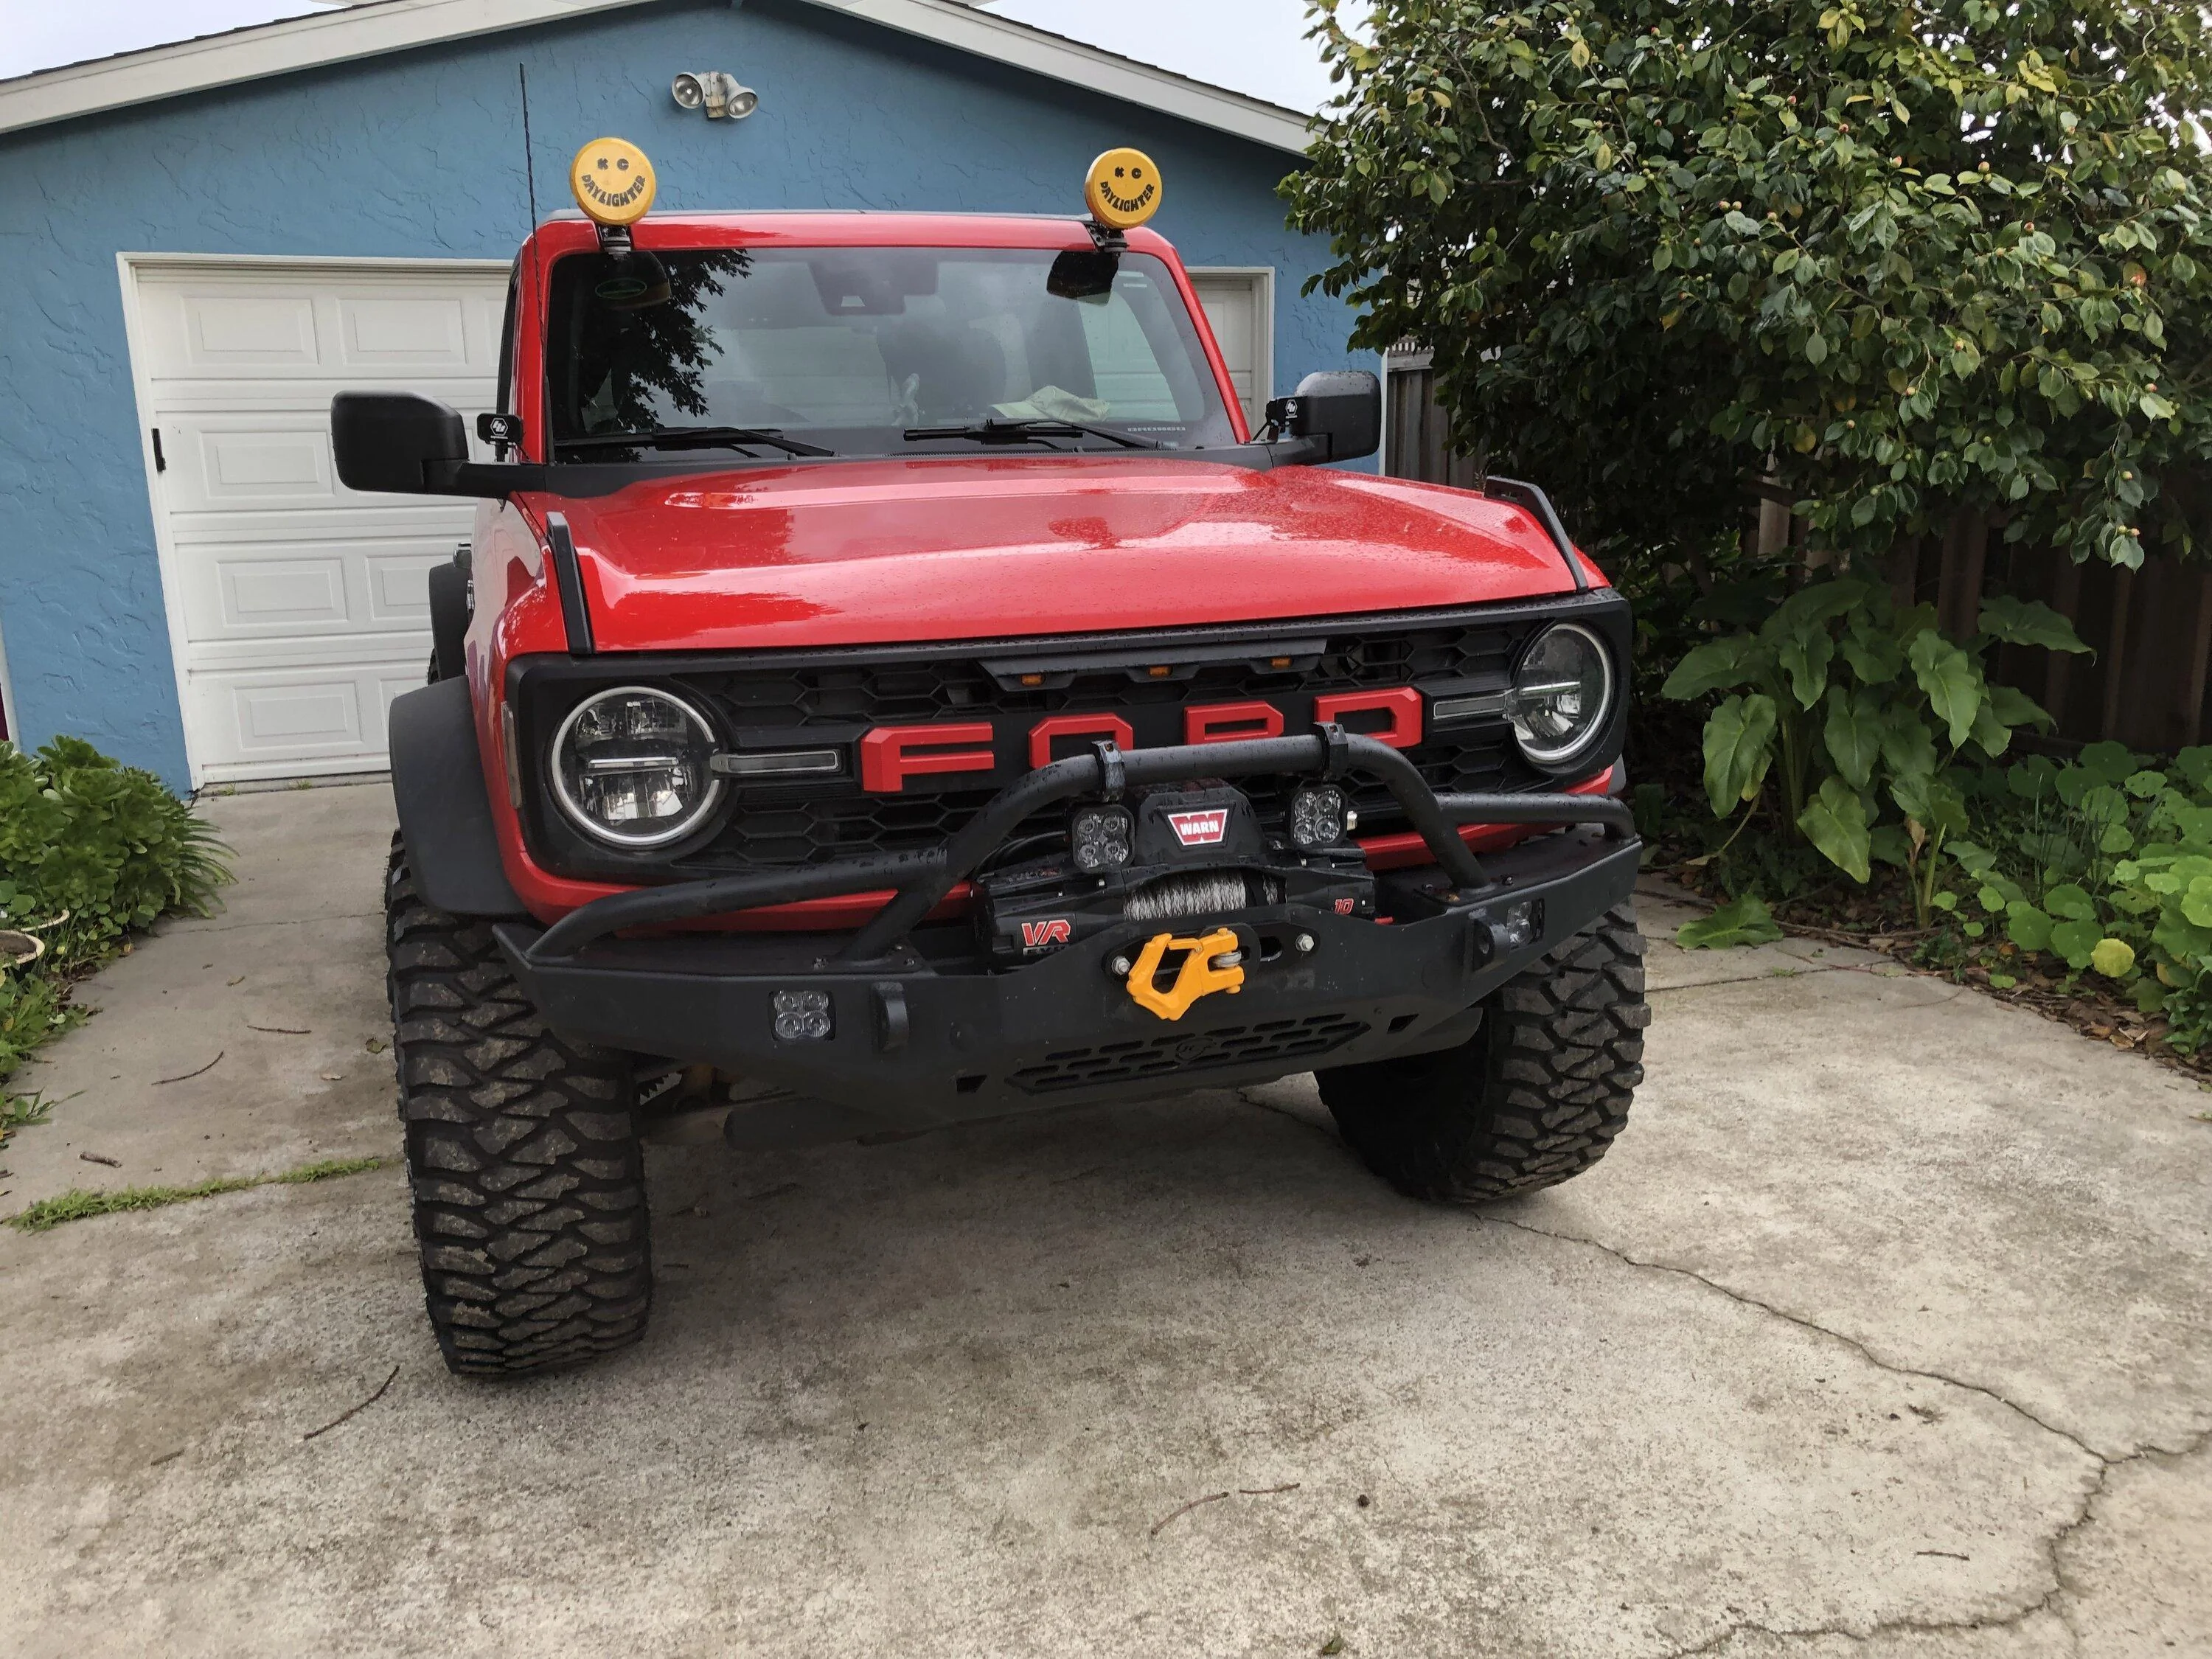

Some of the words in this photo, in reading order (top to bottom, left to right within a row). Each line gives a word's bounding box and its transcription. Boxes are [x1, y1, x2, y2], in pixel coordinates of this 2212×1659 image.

[581, 174, 645, 207] DAYLIGHTER
[1100, 181, 1155, 212] DAYLIGHTER
[861, 686, 1422, 792] FORD
[1180, 821, 1219, 835] WARN
[1335, 898, 1354, 914] 10
[1021, 919, 1071, 947] VR
